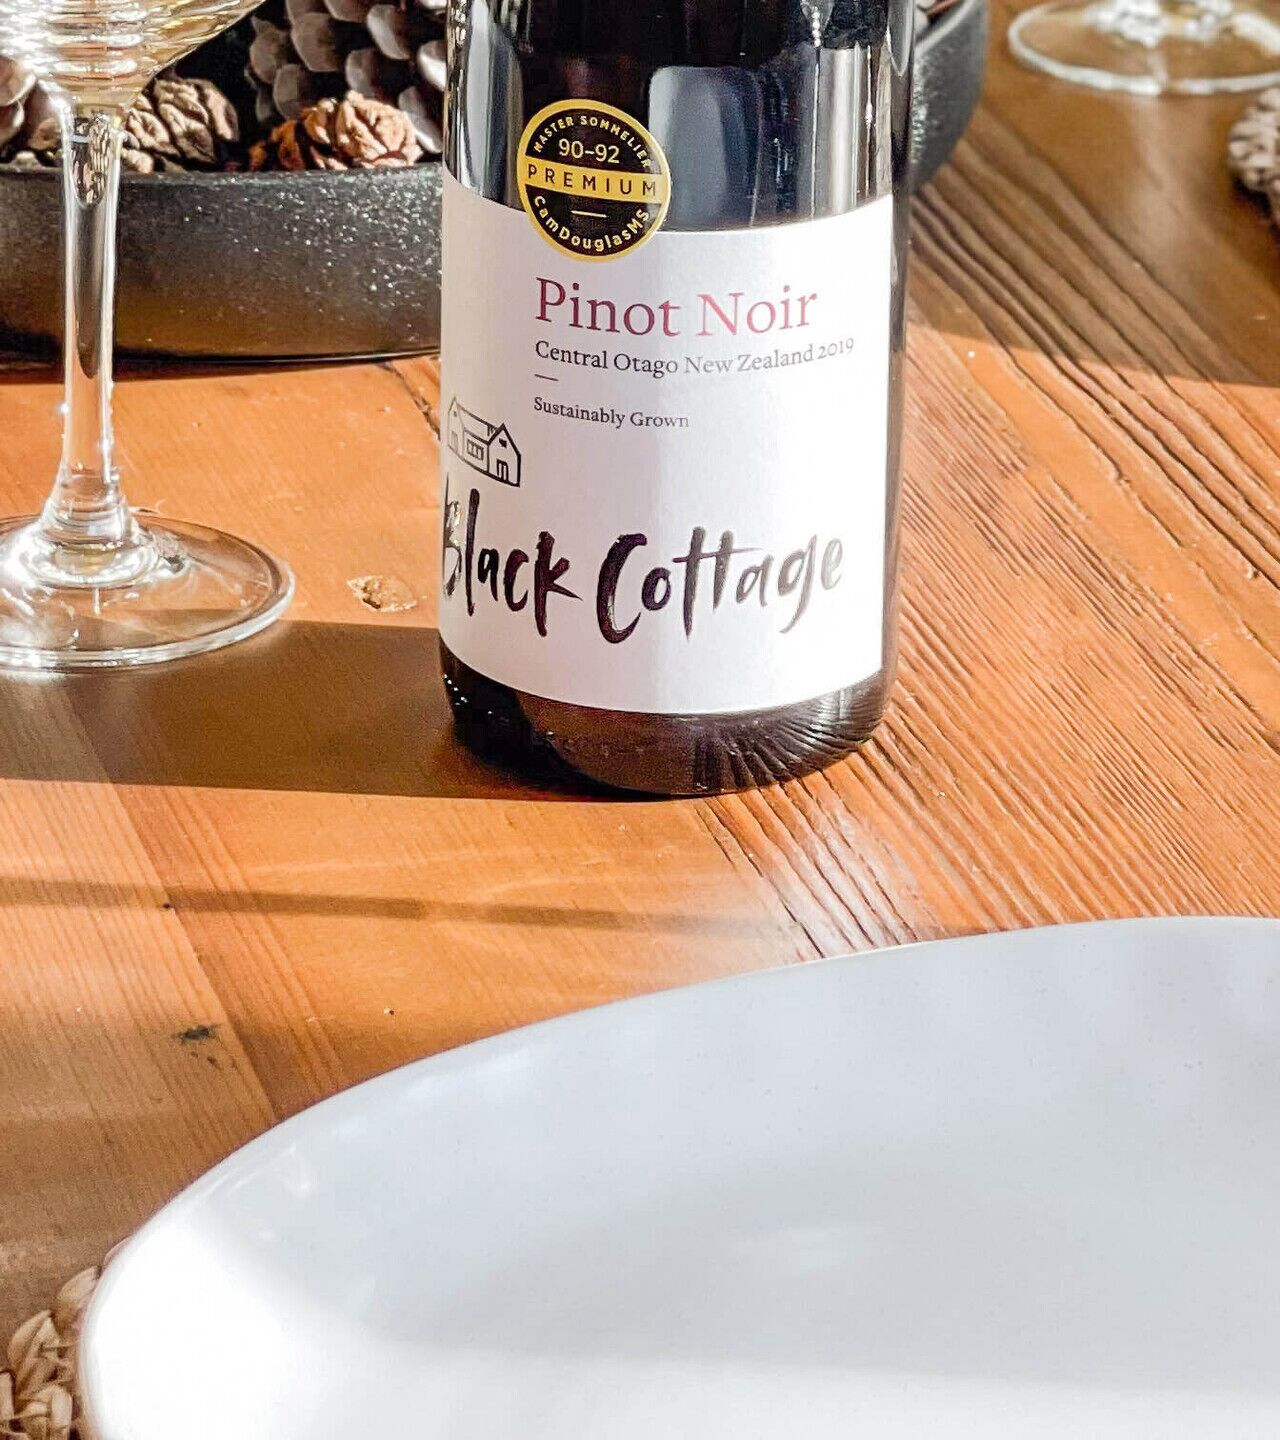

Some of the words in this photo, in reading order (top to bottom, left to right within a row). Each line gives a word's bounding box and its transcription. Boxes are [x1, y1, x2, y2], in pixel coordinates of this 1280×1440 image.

[532, 116, 575, 153] MASTER
[579, 115, 652, 168] SOMMELIER
[558, 138, 620, 164] 90-92
[527, 164, 657, 197] PREMIUM
[533, 195, 650, 252] CamDouglasMS
[535, 277, 680, 337] Pinot
[697, 284, 818, 337] Noir
[534, 339, 609, 370] Central
[613, 352, 679, 379] Otago
[684, 356, 735, 375] New
[736, 343, 814, 373] Zealand
[816, 337, 856, 361] 2019
[533, 396, 626, 430] Sustainably
[629, 410, 690, 429] Grown
[596, 525, 845, 644] Cottage
